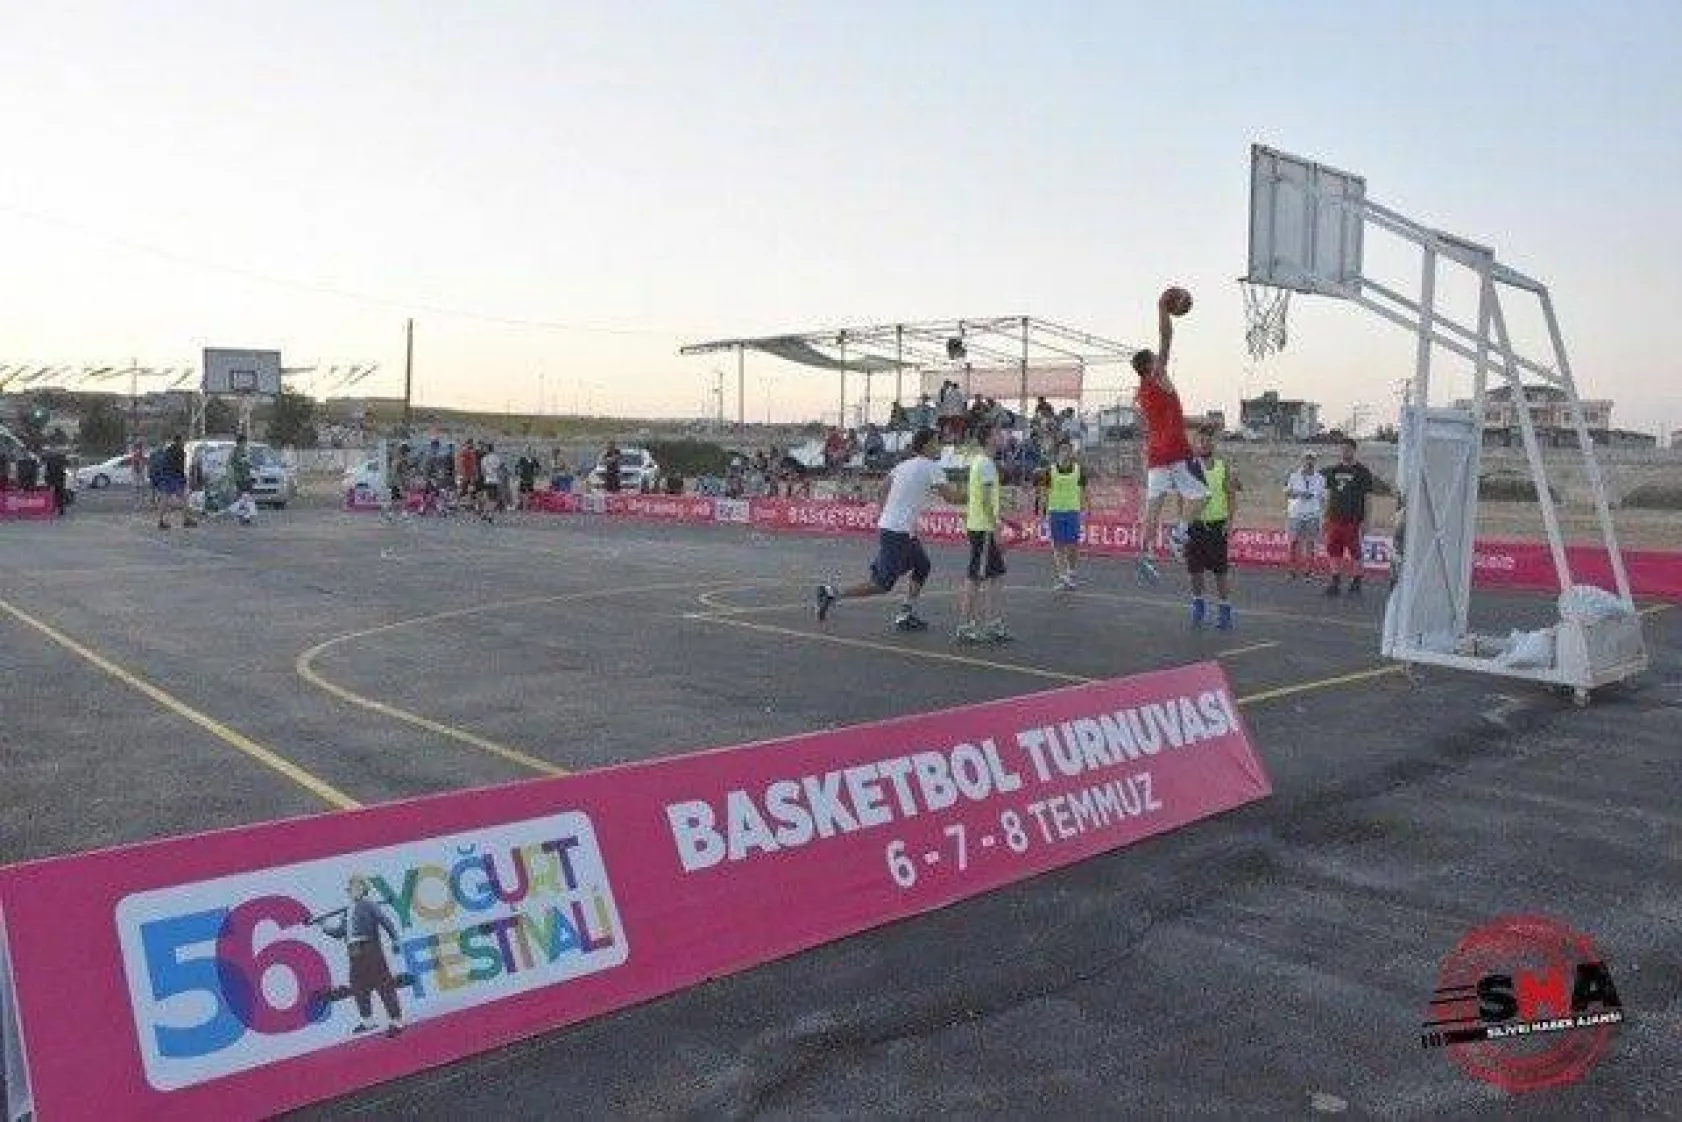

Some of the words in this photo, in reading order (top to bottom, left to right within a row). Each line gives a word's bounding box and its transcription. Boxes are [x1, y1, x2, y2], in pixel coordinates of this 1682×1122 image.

[664, 736, 1021, 873] BASKETBOL
[1017, 690, 1238, 780] TURNUVASI
[885, 839, 917, 889] 6
[943, 823, 970, 872] 7
[998, 808, 1030, 853] 8
[1030, 771, 1163, 846] TEMMUZ
[368, 835, 580, 928] YOĞURT
[140, 894, 333, 1057] 56
